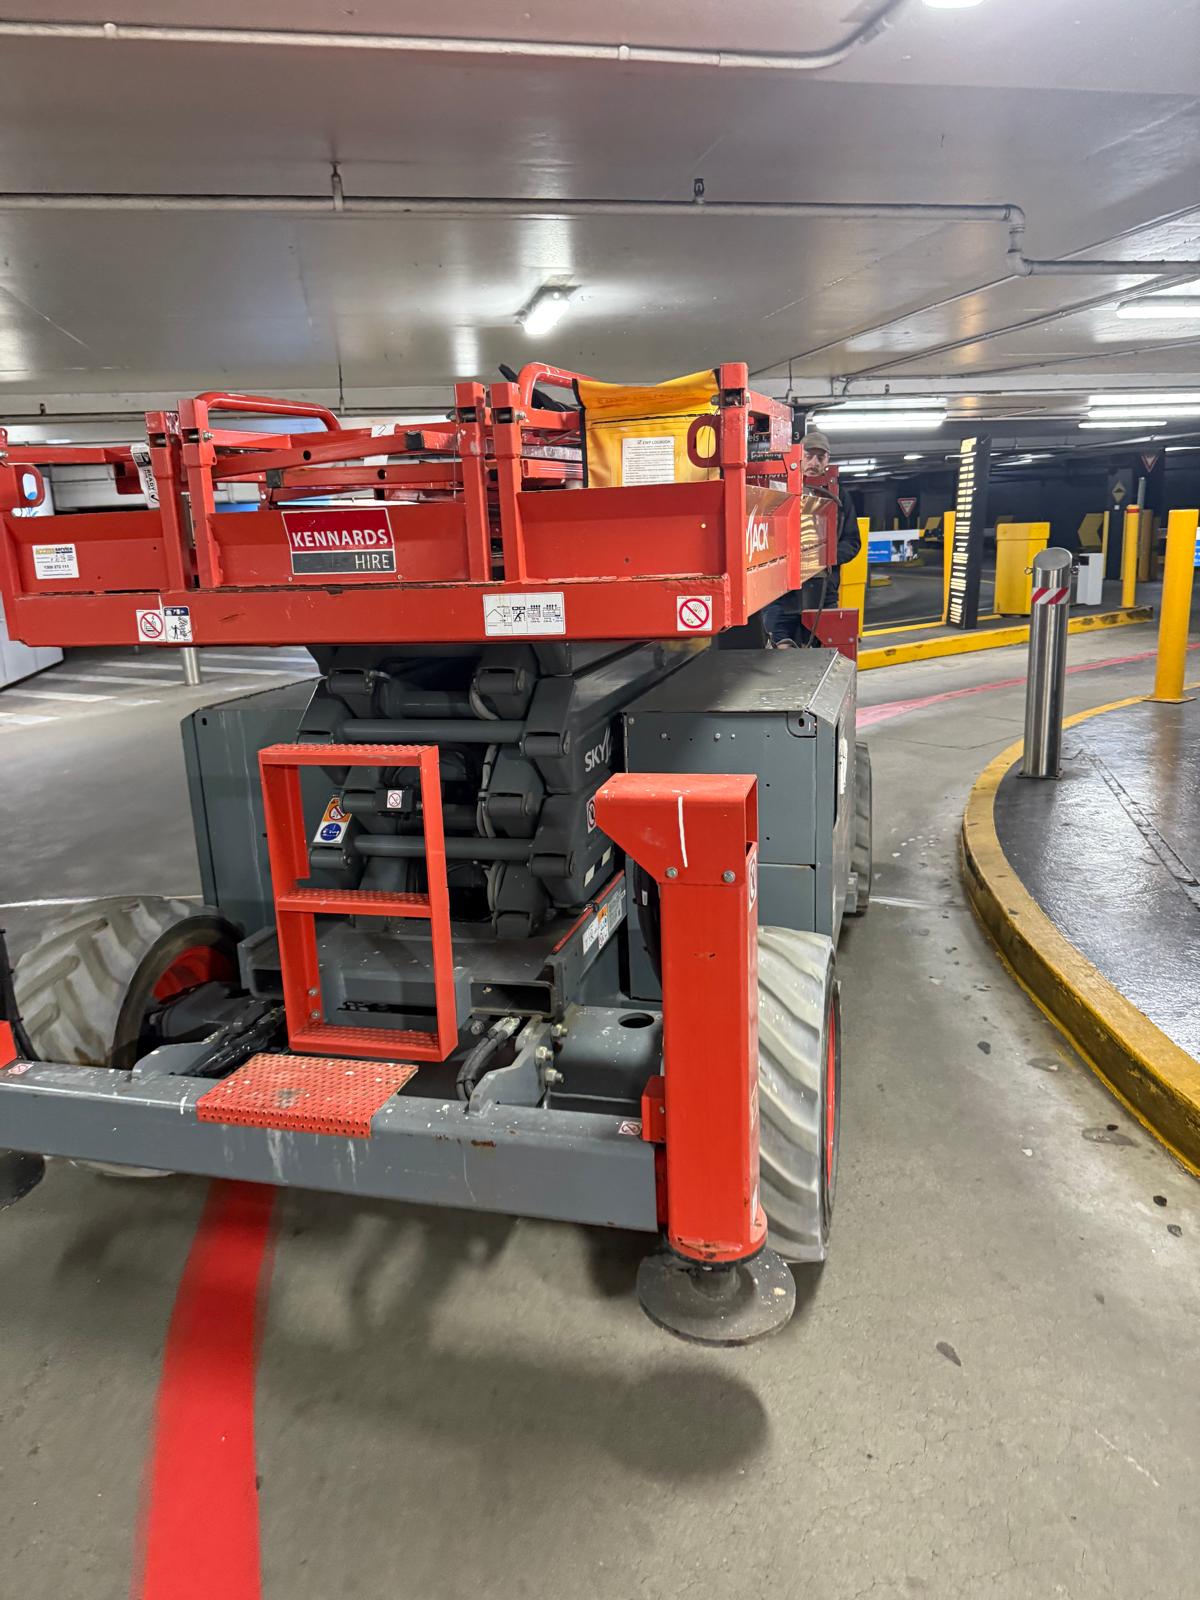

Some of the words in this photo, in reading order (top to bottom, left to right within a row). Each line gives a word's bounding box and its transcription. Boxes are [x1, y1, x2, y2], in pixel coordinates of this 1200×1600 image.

[146, 469, 156, 491] READY
[291, 528, 388, 548] KENNARDS
[354, 553, 391, 570] HIRE
